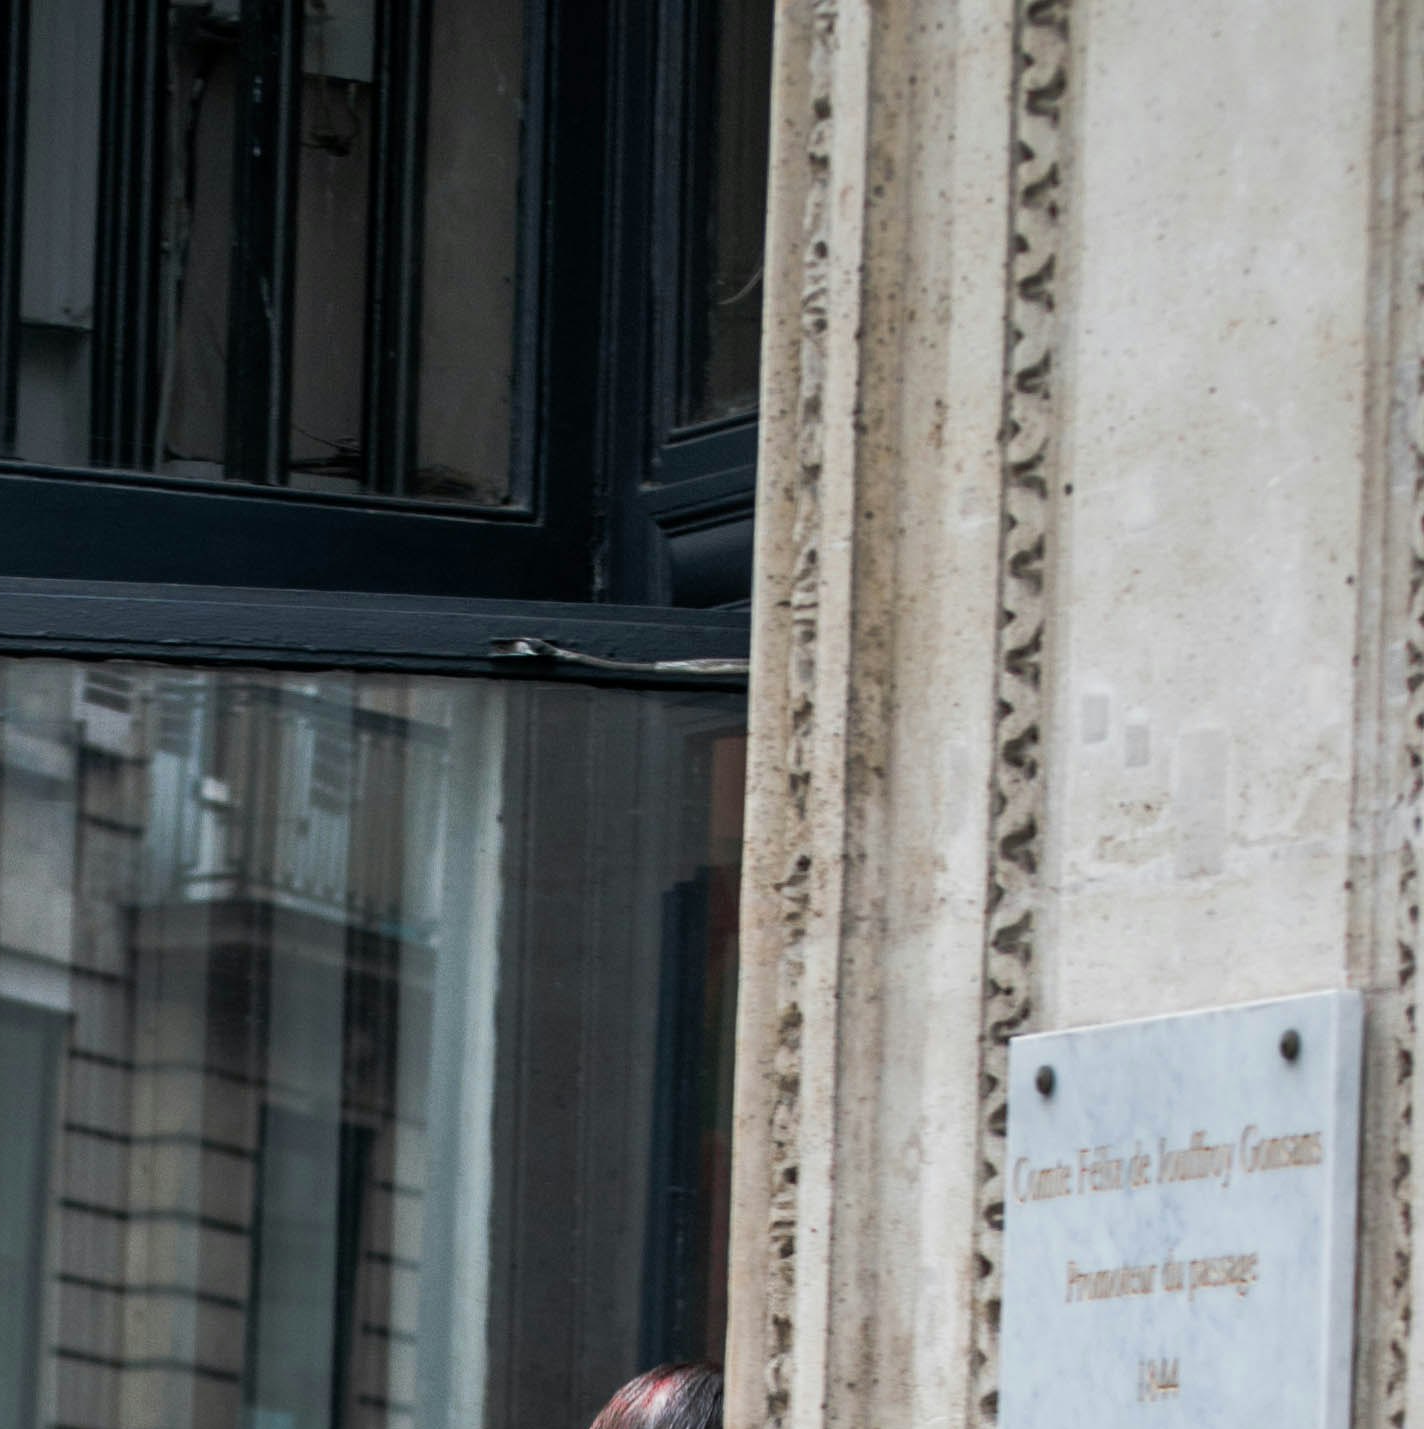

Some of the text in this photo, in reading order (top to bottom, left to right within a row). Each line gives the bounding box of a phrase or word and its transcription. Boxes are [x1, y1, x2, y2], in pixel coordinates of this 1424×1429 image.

[1013, 1157, 1072, 1203] Comte
[1129, 1139, 1152, 1187] de
[1065, 1248, 1258, 1303] Promoteur du passage
